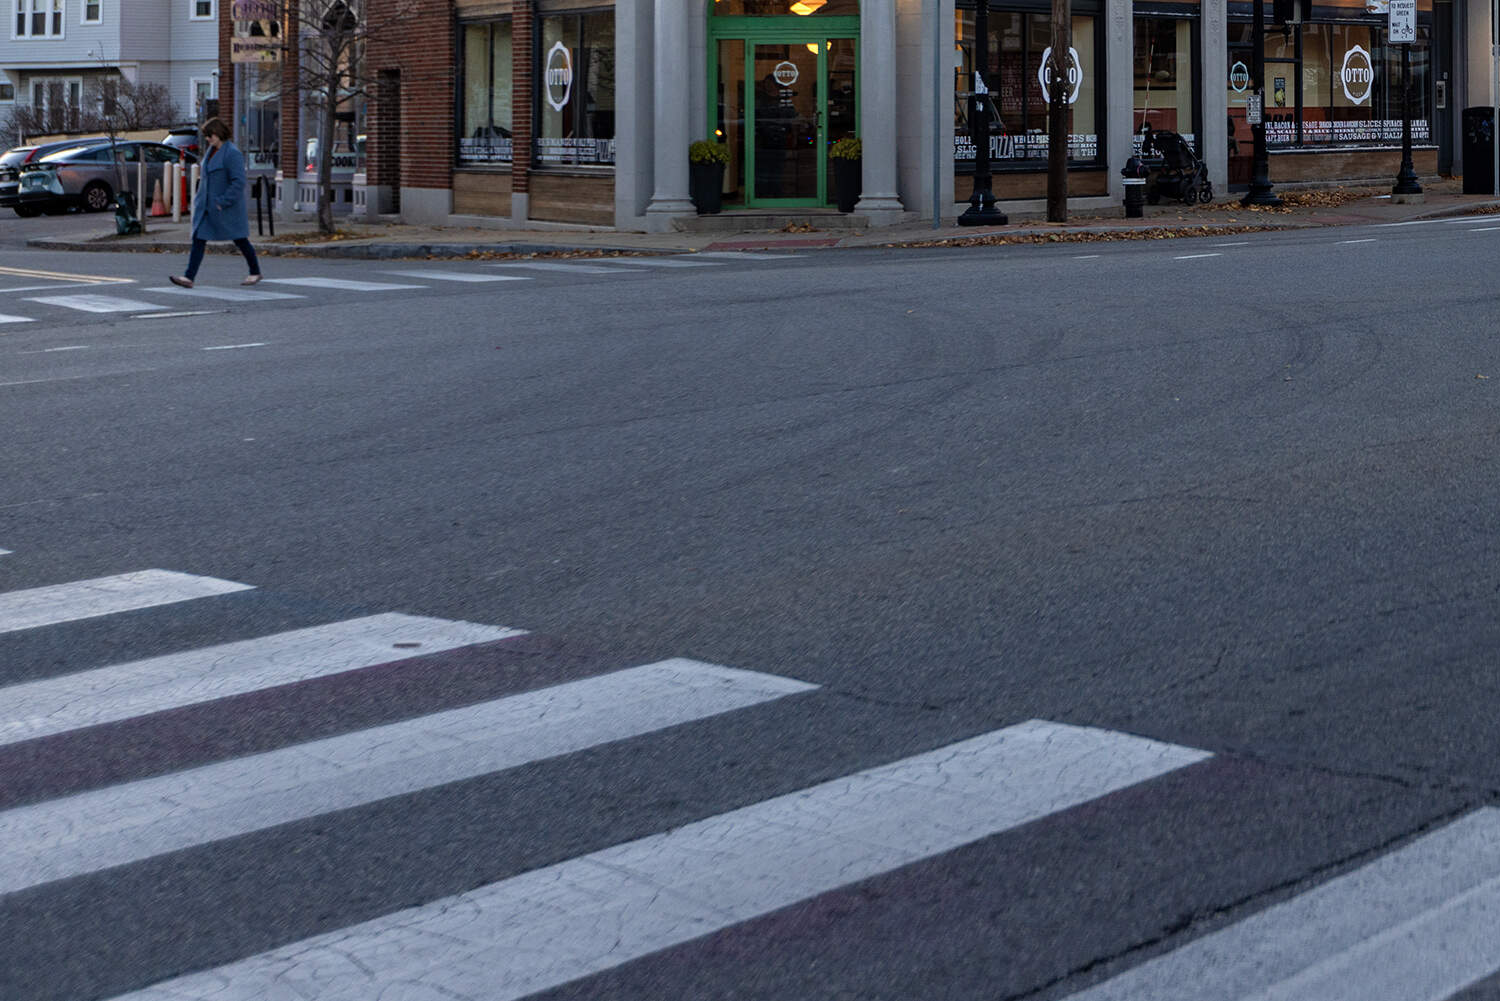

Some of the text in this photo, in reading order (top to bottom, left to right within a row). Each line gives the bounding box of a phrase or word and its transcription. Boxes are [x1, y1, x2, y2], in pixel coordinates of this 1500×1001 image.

[549, 68, 569, 85] OTTO
[1045, 67, 1077, 84] OO
[1231, 73, 1247, 81] OTTO
[1345, 68, 1370, 83] OTTO
[1359, 120, 1381, 128] SLICES
[989, 135, 1015, 159] PIZZA
